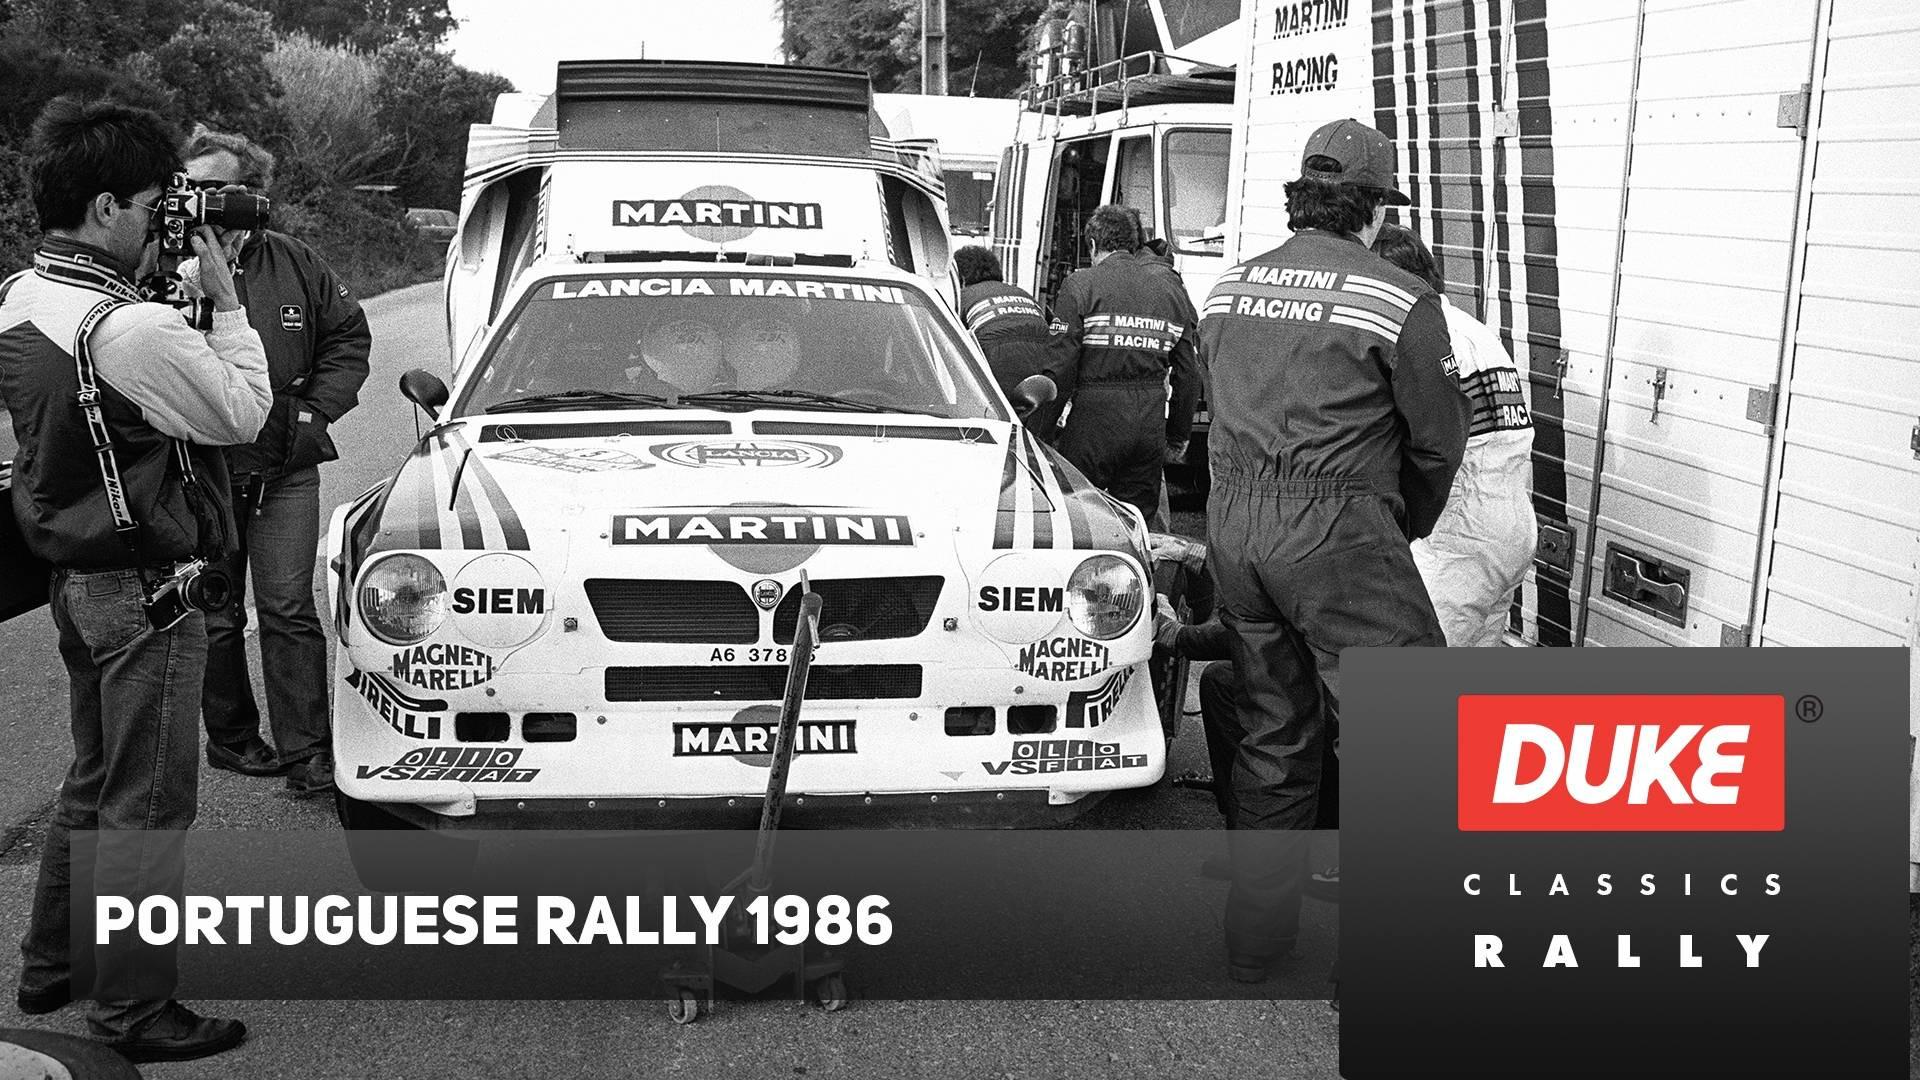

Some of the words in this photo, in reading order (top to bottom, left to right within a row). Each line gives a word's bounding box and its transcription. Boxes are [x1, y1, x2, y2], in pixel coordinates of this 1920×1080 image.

[1273, 0, 1348, 40] MARTINI
[1270, 53, 1338, 95] RACING
[619, 202, 816, 227] MARTINI
[1246, 266, 1338, 289] MARTINI
[552, 278, 714, 299] LANCIA
[729, 278, 905, 304] MARTINI
[998, 306, 1041, 317] RACING
[1236, 296, 1324, 321] RACING
[1115, 315, 1166, 331] MARTINI
[1113, 334, 1161, 350] RACING
[107, 477, 123, 520] Nikon
[625, 516, 902, 541] MARTINI
[452, 588, 545, 615] SIEM
[978, 586, 1064, 612] SIEM
[393, 643, 493, 676] MAGNETI
[710, 648, 736, 662] A6
[1019, 637, 1110, 669] MAGNETI
[393, 659, 493, 691] MARELLI
[1019, 653, 1110, 681] MARELLI
[404, 750, 516, 767] OLIO
[1016, 743, 1115, 758] OLIO
